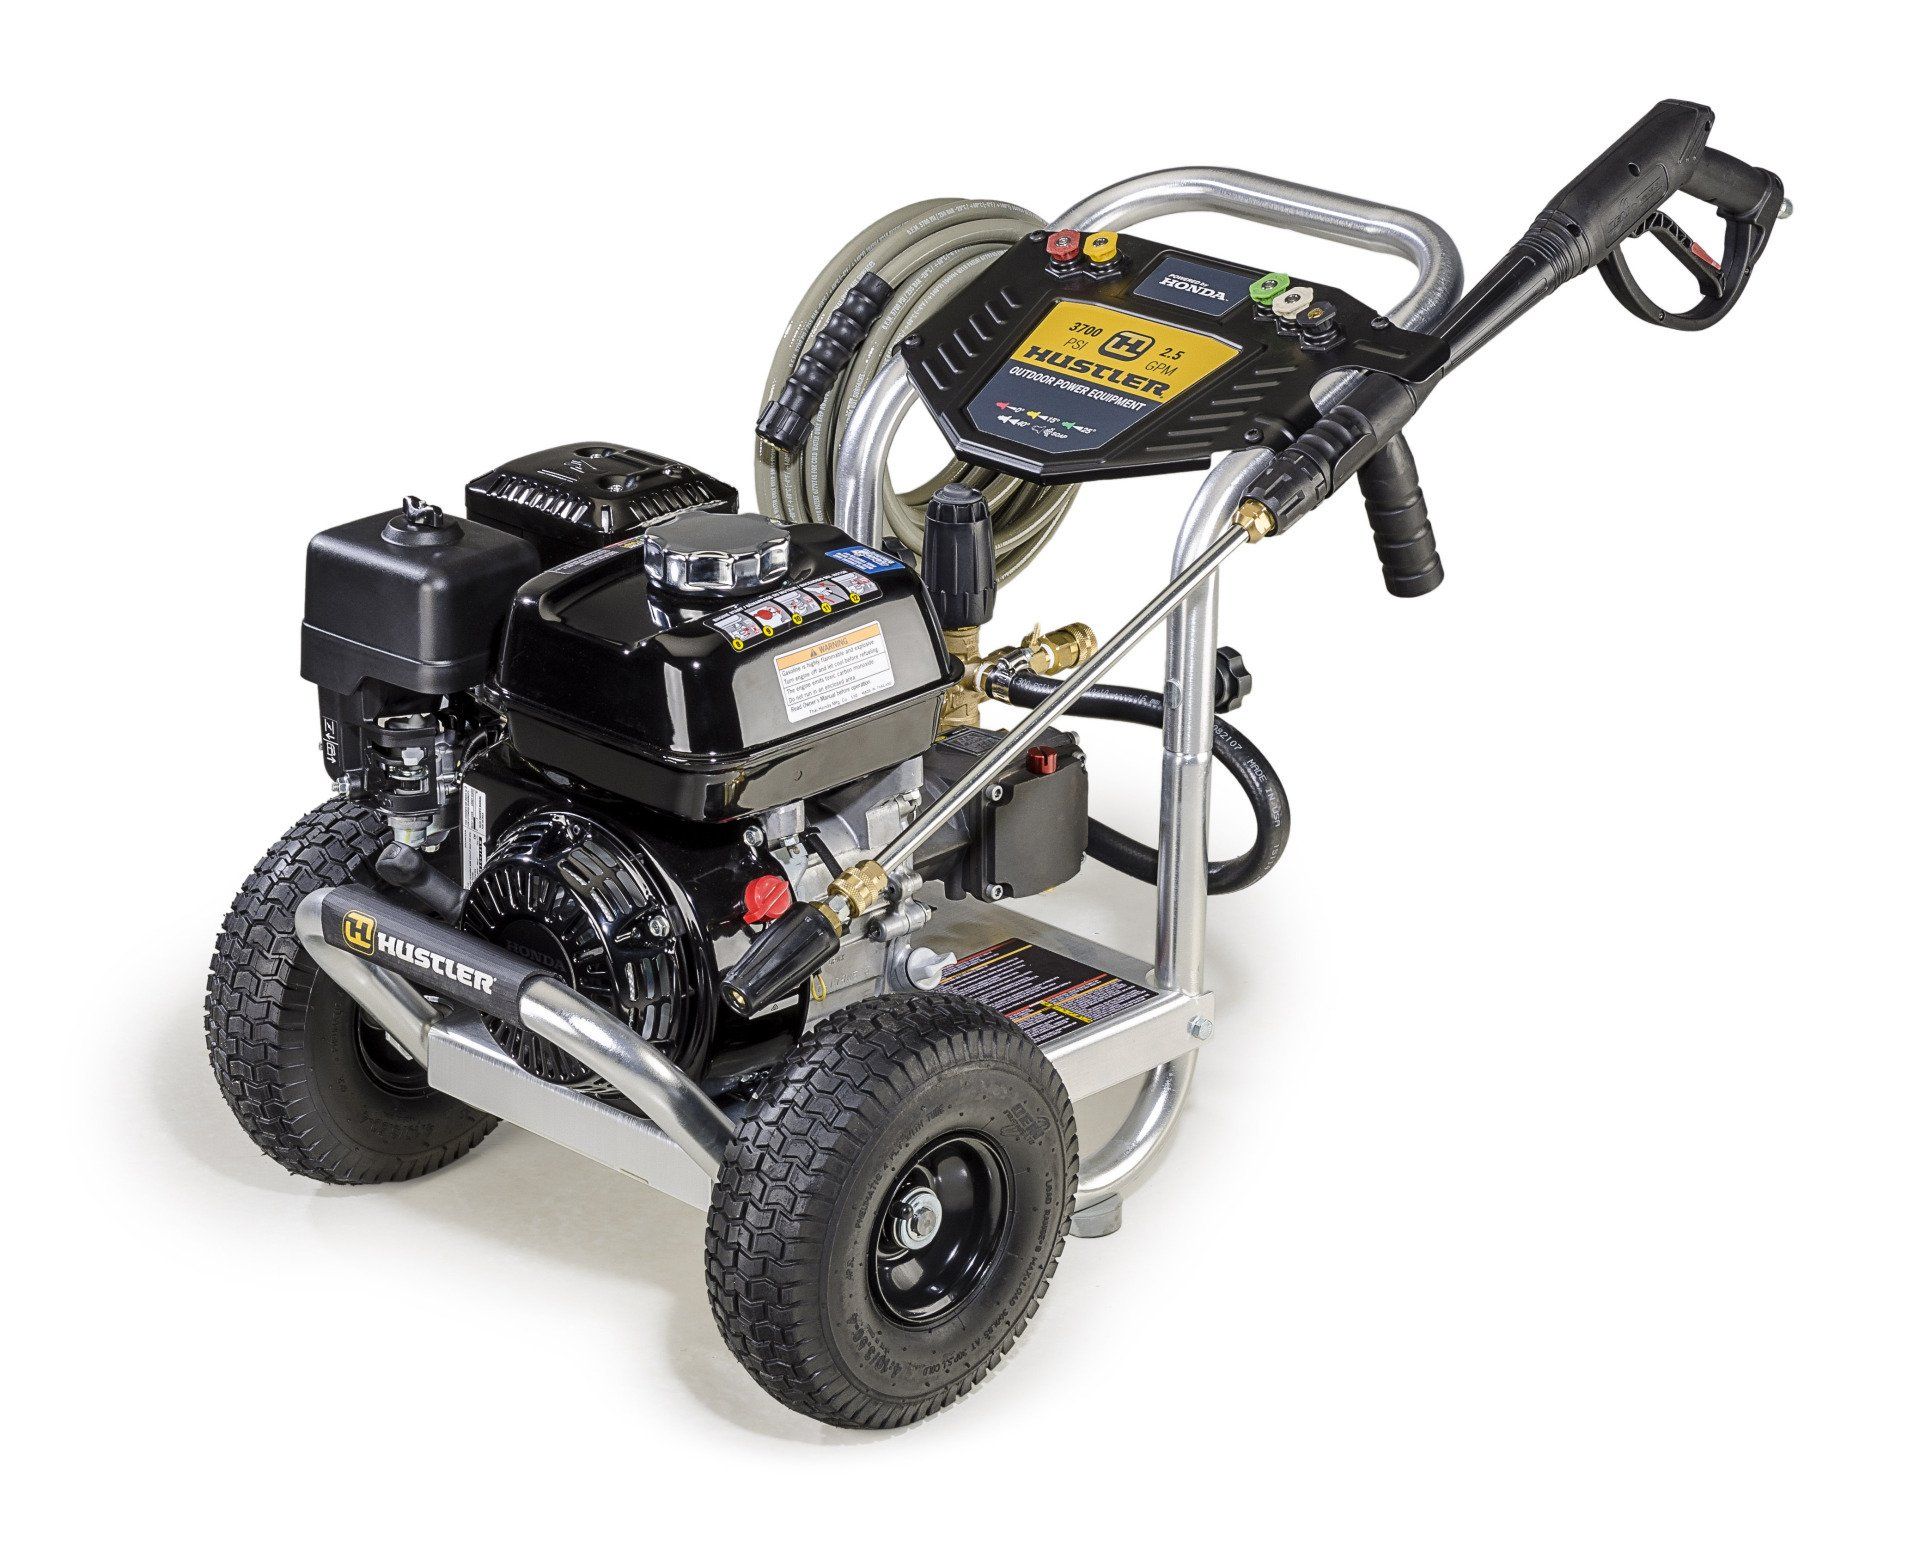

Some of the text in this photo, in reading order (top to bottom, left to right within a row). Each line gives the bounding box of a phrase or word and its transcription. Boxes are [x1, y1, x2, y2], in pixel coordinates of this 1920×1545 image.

[1159, 277, 1227, 301] HONDA
[1063, 338, 1179, 376] PSI GPM
[1069, 322, 1104, 337] 3700
[1158, 347, 1186, 361] 2.5
[1009, 366, 1147, 412] OUTDOOR POWER EQUIPMENT
[1023, 345, 1171, 397] HUSTLER
[819, 637, 848, 653] WARNING
[854, 640, 874, 651] explosive
[820, 691, 836, 701] Manual
[1247, 758, 1268, 783] MADE
[1265, 787, 1276, 801] IN
[1272, 804, 1282, 828] USA
[377, 932, 494, 995] HUSTLER
